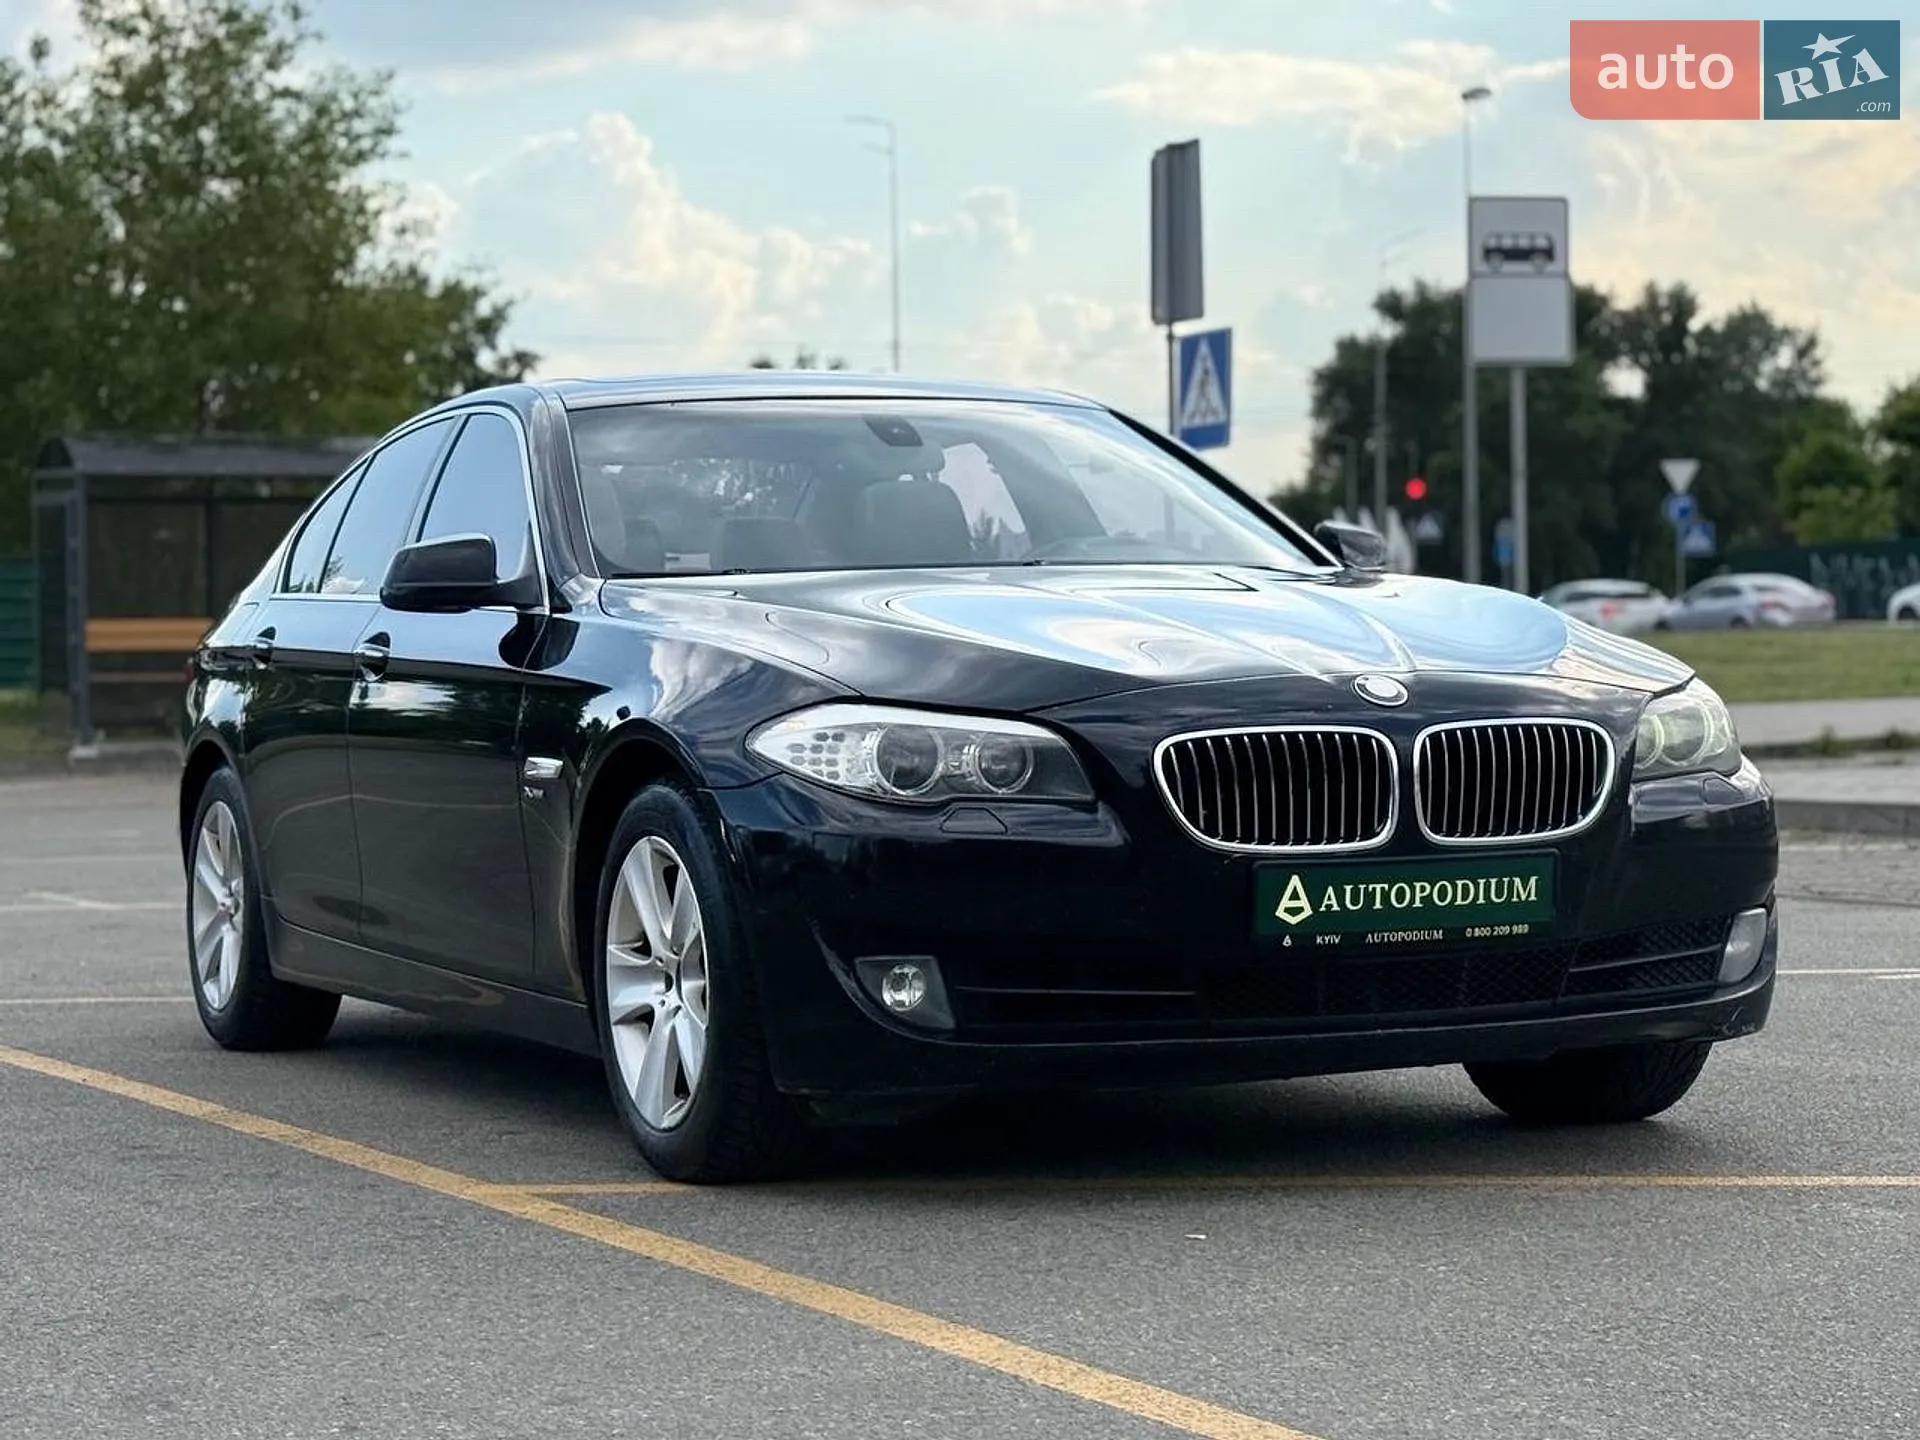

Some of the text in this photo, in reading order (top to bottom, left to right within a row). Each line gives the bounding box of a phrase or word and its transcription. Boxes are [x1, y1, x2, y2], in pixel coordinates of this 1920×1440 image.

[1319, 876, 1540, 912] AUTOPODIUM
[1315, 934, 1342, 946] KYIV
[1364, 929, 1444, 945] AUTOPODIUM
